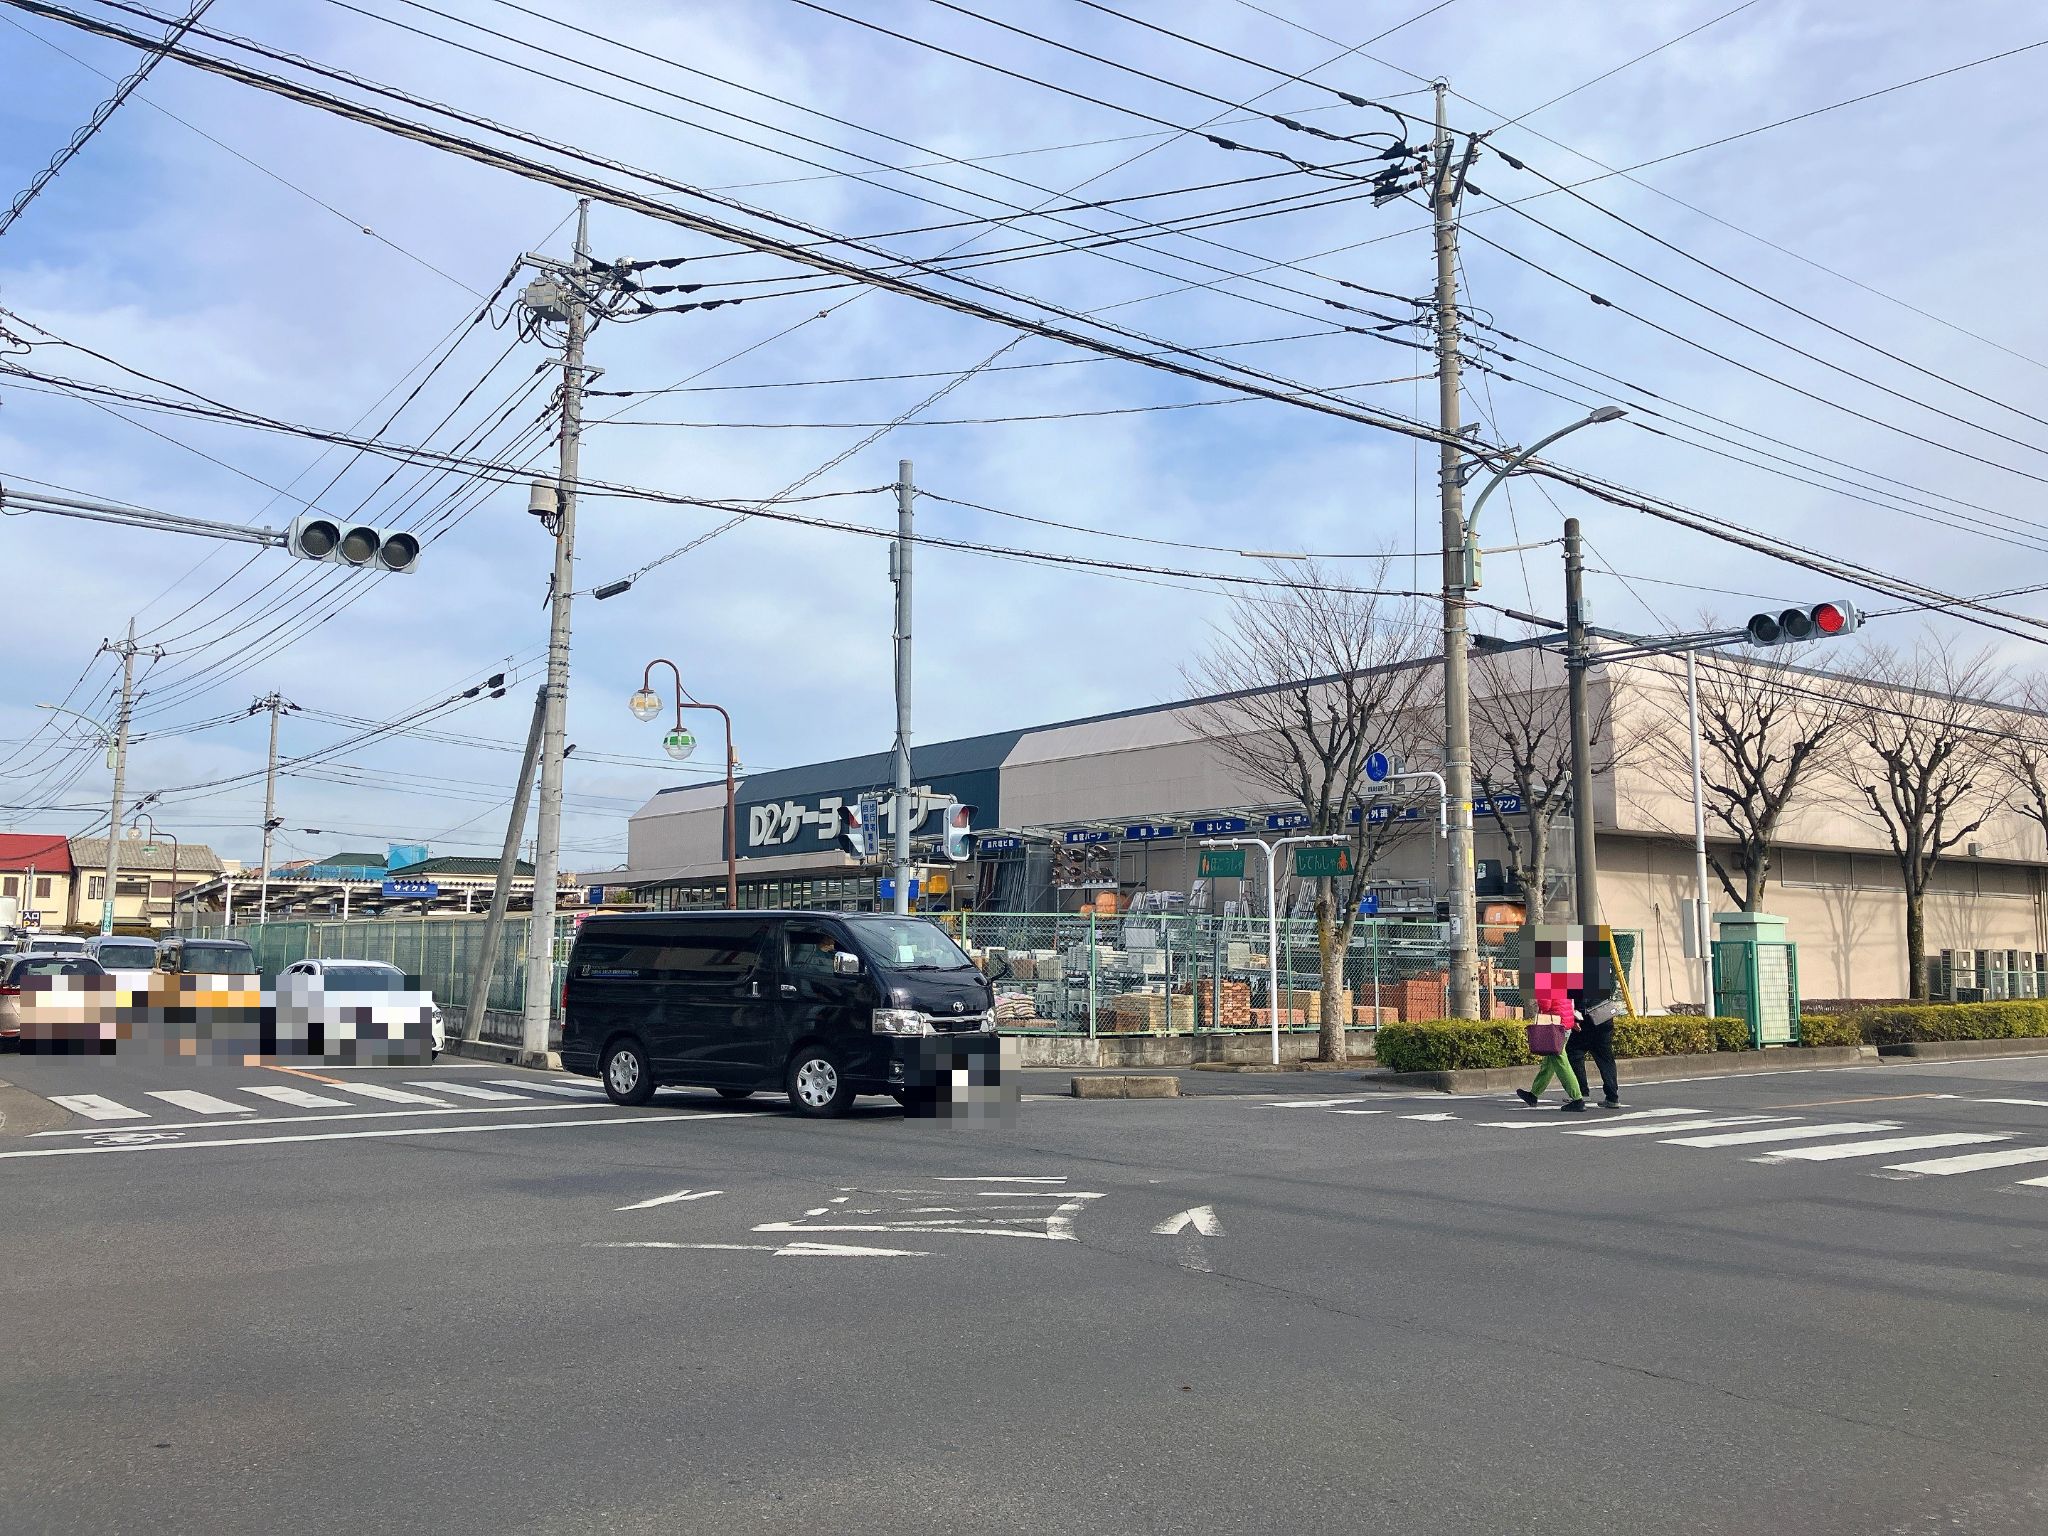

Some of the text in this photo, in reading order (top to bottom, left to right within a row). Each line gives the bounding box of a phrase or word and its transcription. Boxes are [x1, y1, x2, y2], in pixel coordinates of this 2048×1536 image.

[1206, 821, 1232, 832] はしご
[393, 884, 428, 892] サイクル
[23, 912, 40, 920] 入口
